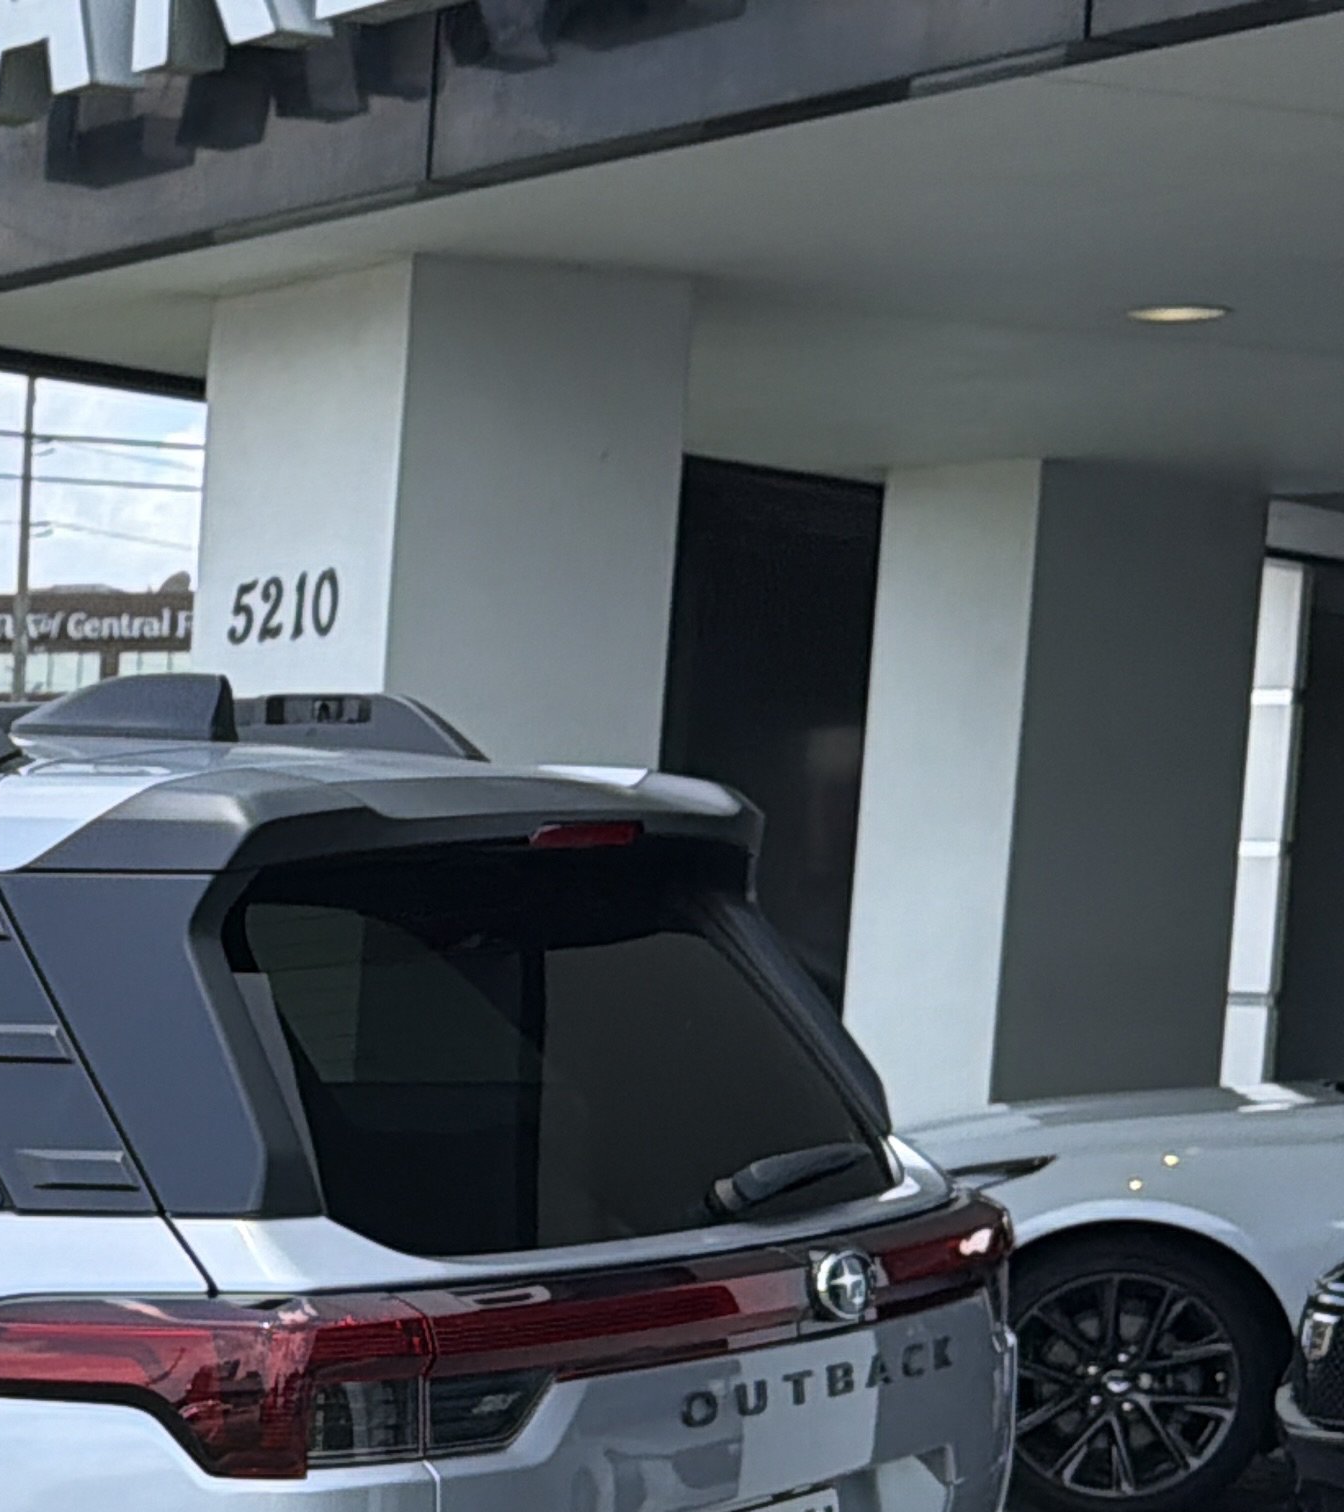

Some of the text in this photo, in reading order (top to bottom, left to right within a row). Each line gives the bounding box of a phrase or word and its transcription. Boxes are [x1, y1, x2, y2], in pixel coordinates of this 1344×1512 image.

[67, 607, 171, 640] Central
[226, 566, 339, 646] 5210
[681, 1335, 953, 1428] OUTBACK
